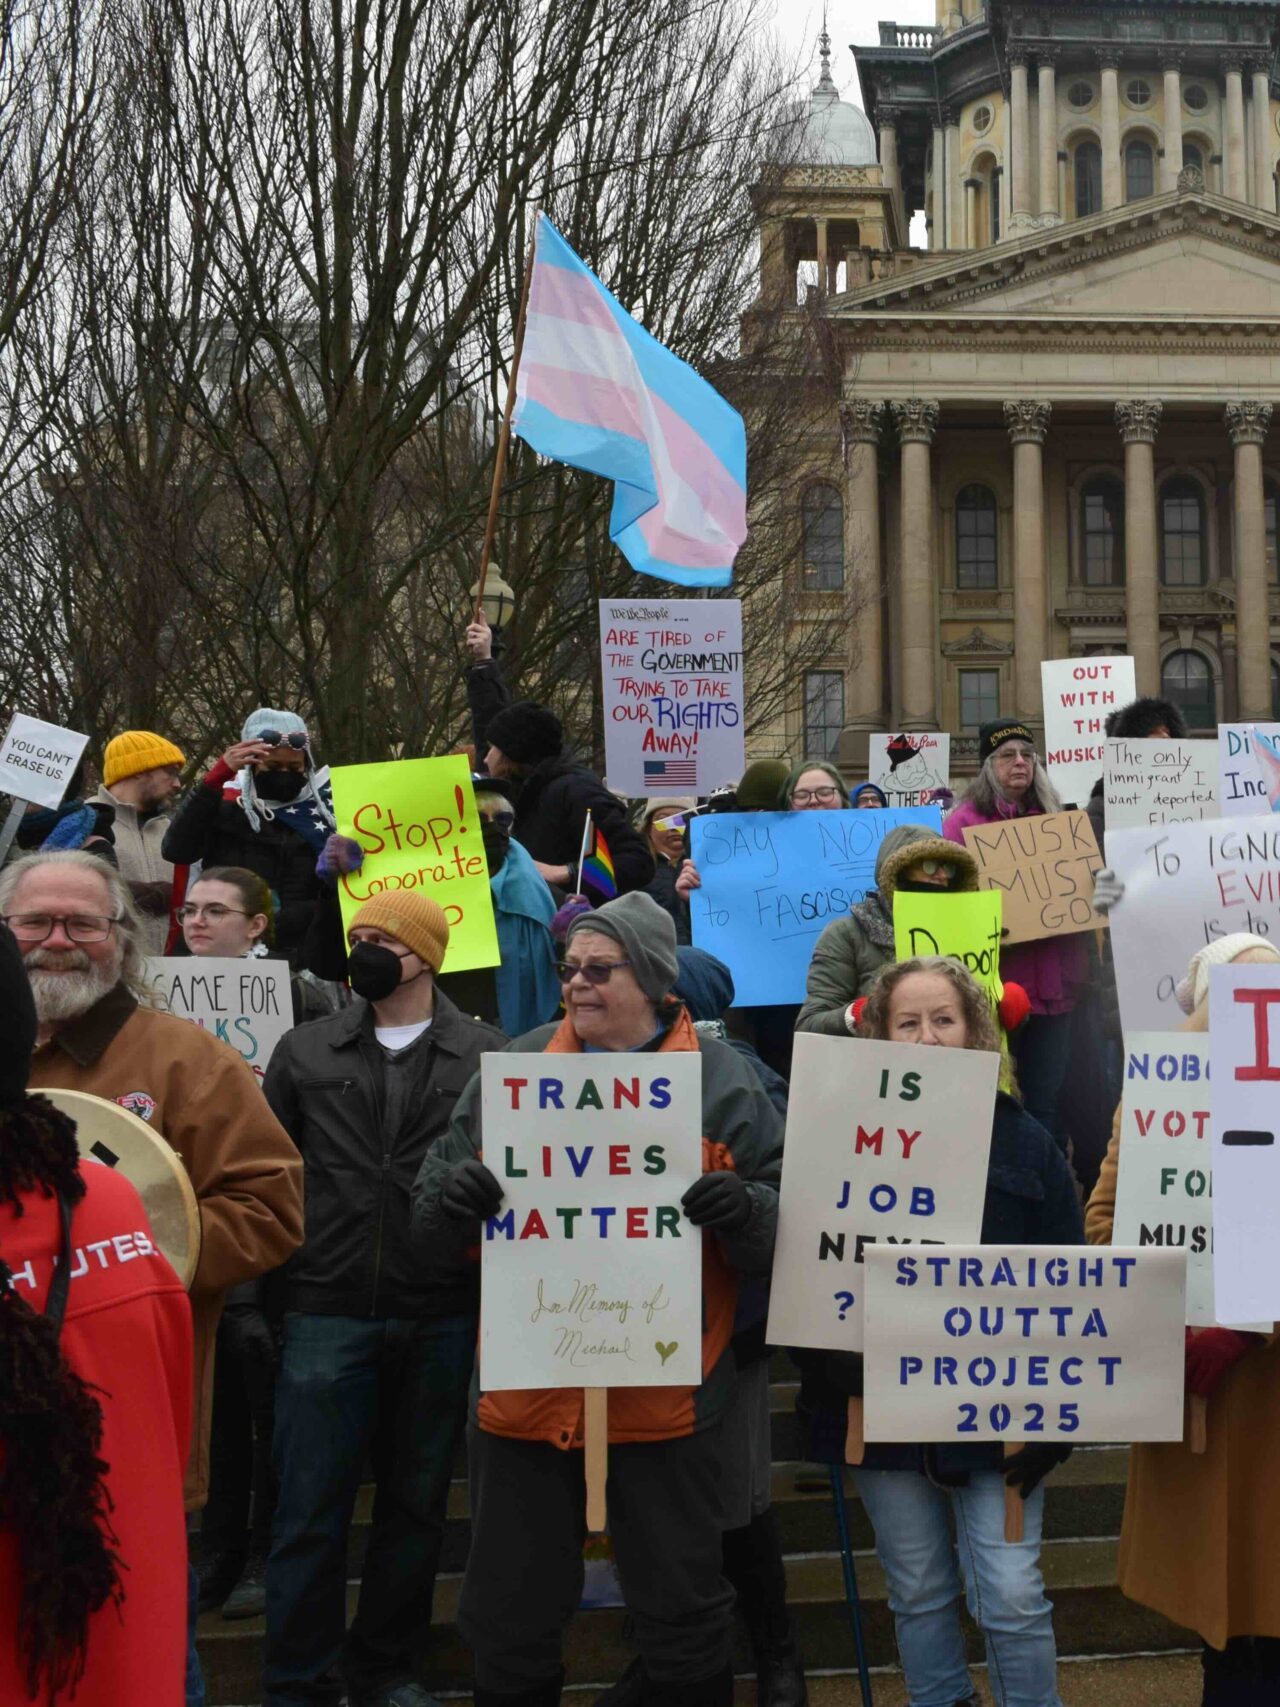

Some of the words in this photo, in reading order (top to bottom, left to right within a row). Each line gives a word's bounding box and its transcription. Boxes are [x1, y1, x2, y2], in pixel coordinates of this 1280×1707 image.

[638, 608, 669, 621] People
[605, 628, 639, 646] ARE
[644, 629, 691, 648] TIRED
[704, 631, 727, 642] OF
[605, 653, 634, 668] THE
[641, 649, 743, 672] GOVERNMENT
[1073, 665, 1112, 681] OUT
[612, 677, 666, 700] TRYING
[669, 680, 688, 698] TO
[690, 679, 731, 699] TAKE
[1060, 691, 1115, 707] WITH
[612, 703, 653, 723] OUR
[651, 697, 739, 730] RIGHTS
[1073, 718, 1101, 734] TH
[11, 738, 35, 754] YOU
[36, 747, 73, 766] CAN'T
[642, 727, 699, 759] AWAY!
[1109, 742, 1142, 766] The
[1153, 746, 1191, 773] only
[5, 753, 45, 774] ERASE
[45, 766, 65, 781] US.
[1109, 769, 1183, 790] Immigrant
[1194, 770, 1206, 786] I
[1107, 791, 1142, 805] want
[1153, 790, 1215, 810] deported
[353, 784, 467, 856] Stop!
[703, 821, 779, 878] SAY
[973, 815, 1092, 867] MUSK
[988, 854, 1100, 903] MUST
[703, 896, 730, 927] to
[1039, 897, 1092, 930] GO
[1247, 910, 1269, 937] to
[239, 975, 280, 1016] FOR
[1127, 1053, 1210, 1082] NOB
[503, 1076, 672, 1110] TRANS
[879, 1069, 922, 1101] IS
[1133, 1109, 1210, 1139] VOT
[855, 1125, 922, 1159] MY
[505, 1145, 667, 1178] LIVES
[836, 1181, 936, 1216] JOB
[1160, 1168, 1213, 1198] FO
[486, 1206, 682, 1241] MATTER
[1139, 1223, 1214, 1254] MUS
[895, 1256, 1137, 1288] STRAIGHT
[567, 1278, 633, 1324] Memory
[641, 1283, 670, 1324] of
[834, 1290, 855, 1321] ?
[944, 1306, 1108, 1337] OUTTA
[552, 1326, 636, 1368] Michael
[900, 1356, 1122, 1387] PROJECT
[957, 1403, 1080, 1432] 2025
